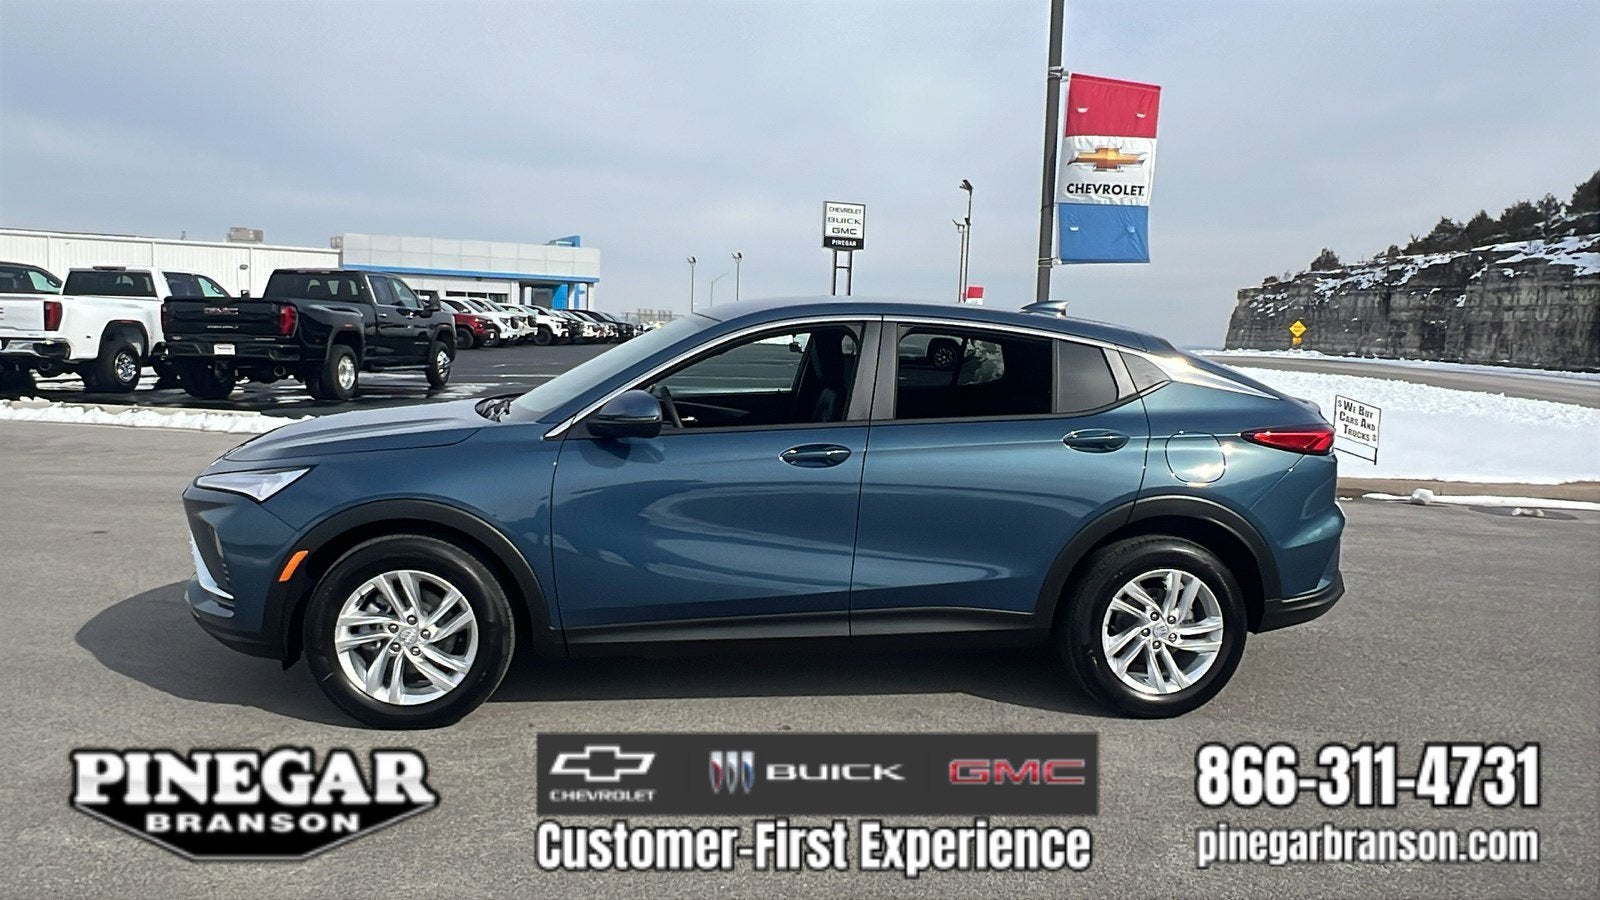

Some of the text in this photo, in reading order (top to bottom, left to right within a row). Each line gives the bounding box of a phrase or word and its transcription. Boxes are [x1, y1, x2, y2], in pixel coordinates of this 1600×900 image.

[1066, 182, 1145, 197] CHEVROLET
[828, 206, 862, 215] CHEVROLET
[827, 216, 861, 226] BUICK
[832, 227, 857, 235] GMC
[831, 239, 857, 247] PINEGAR
